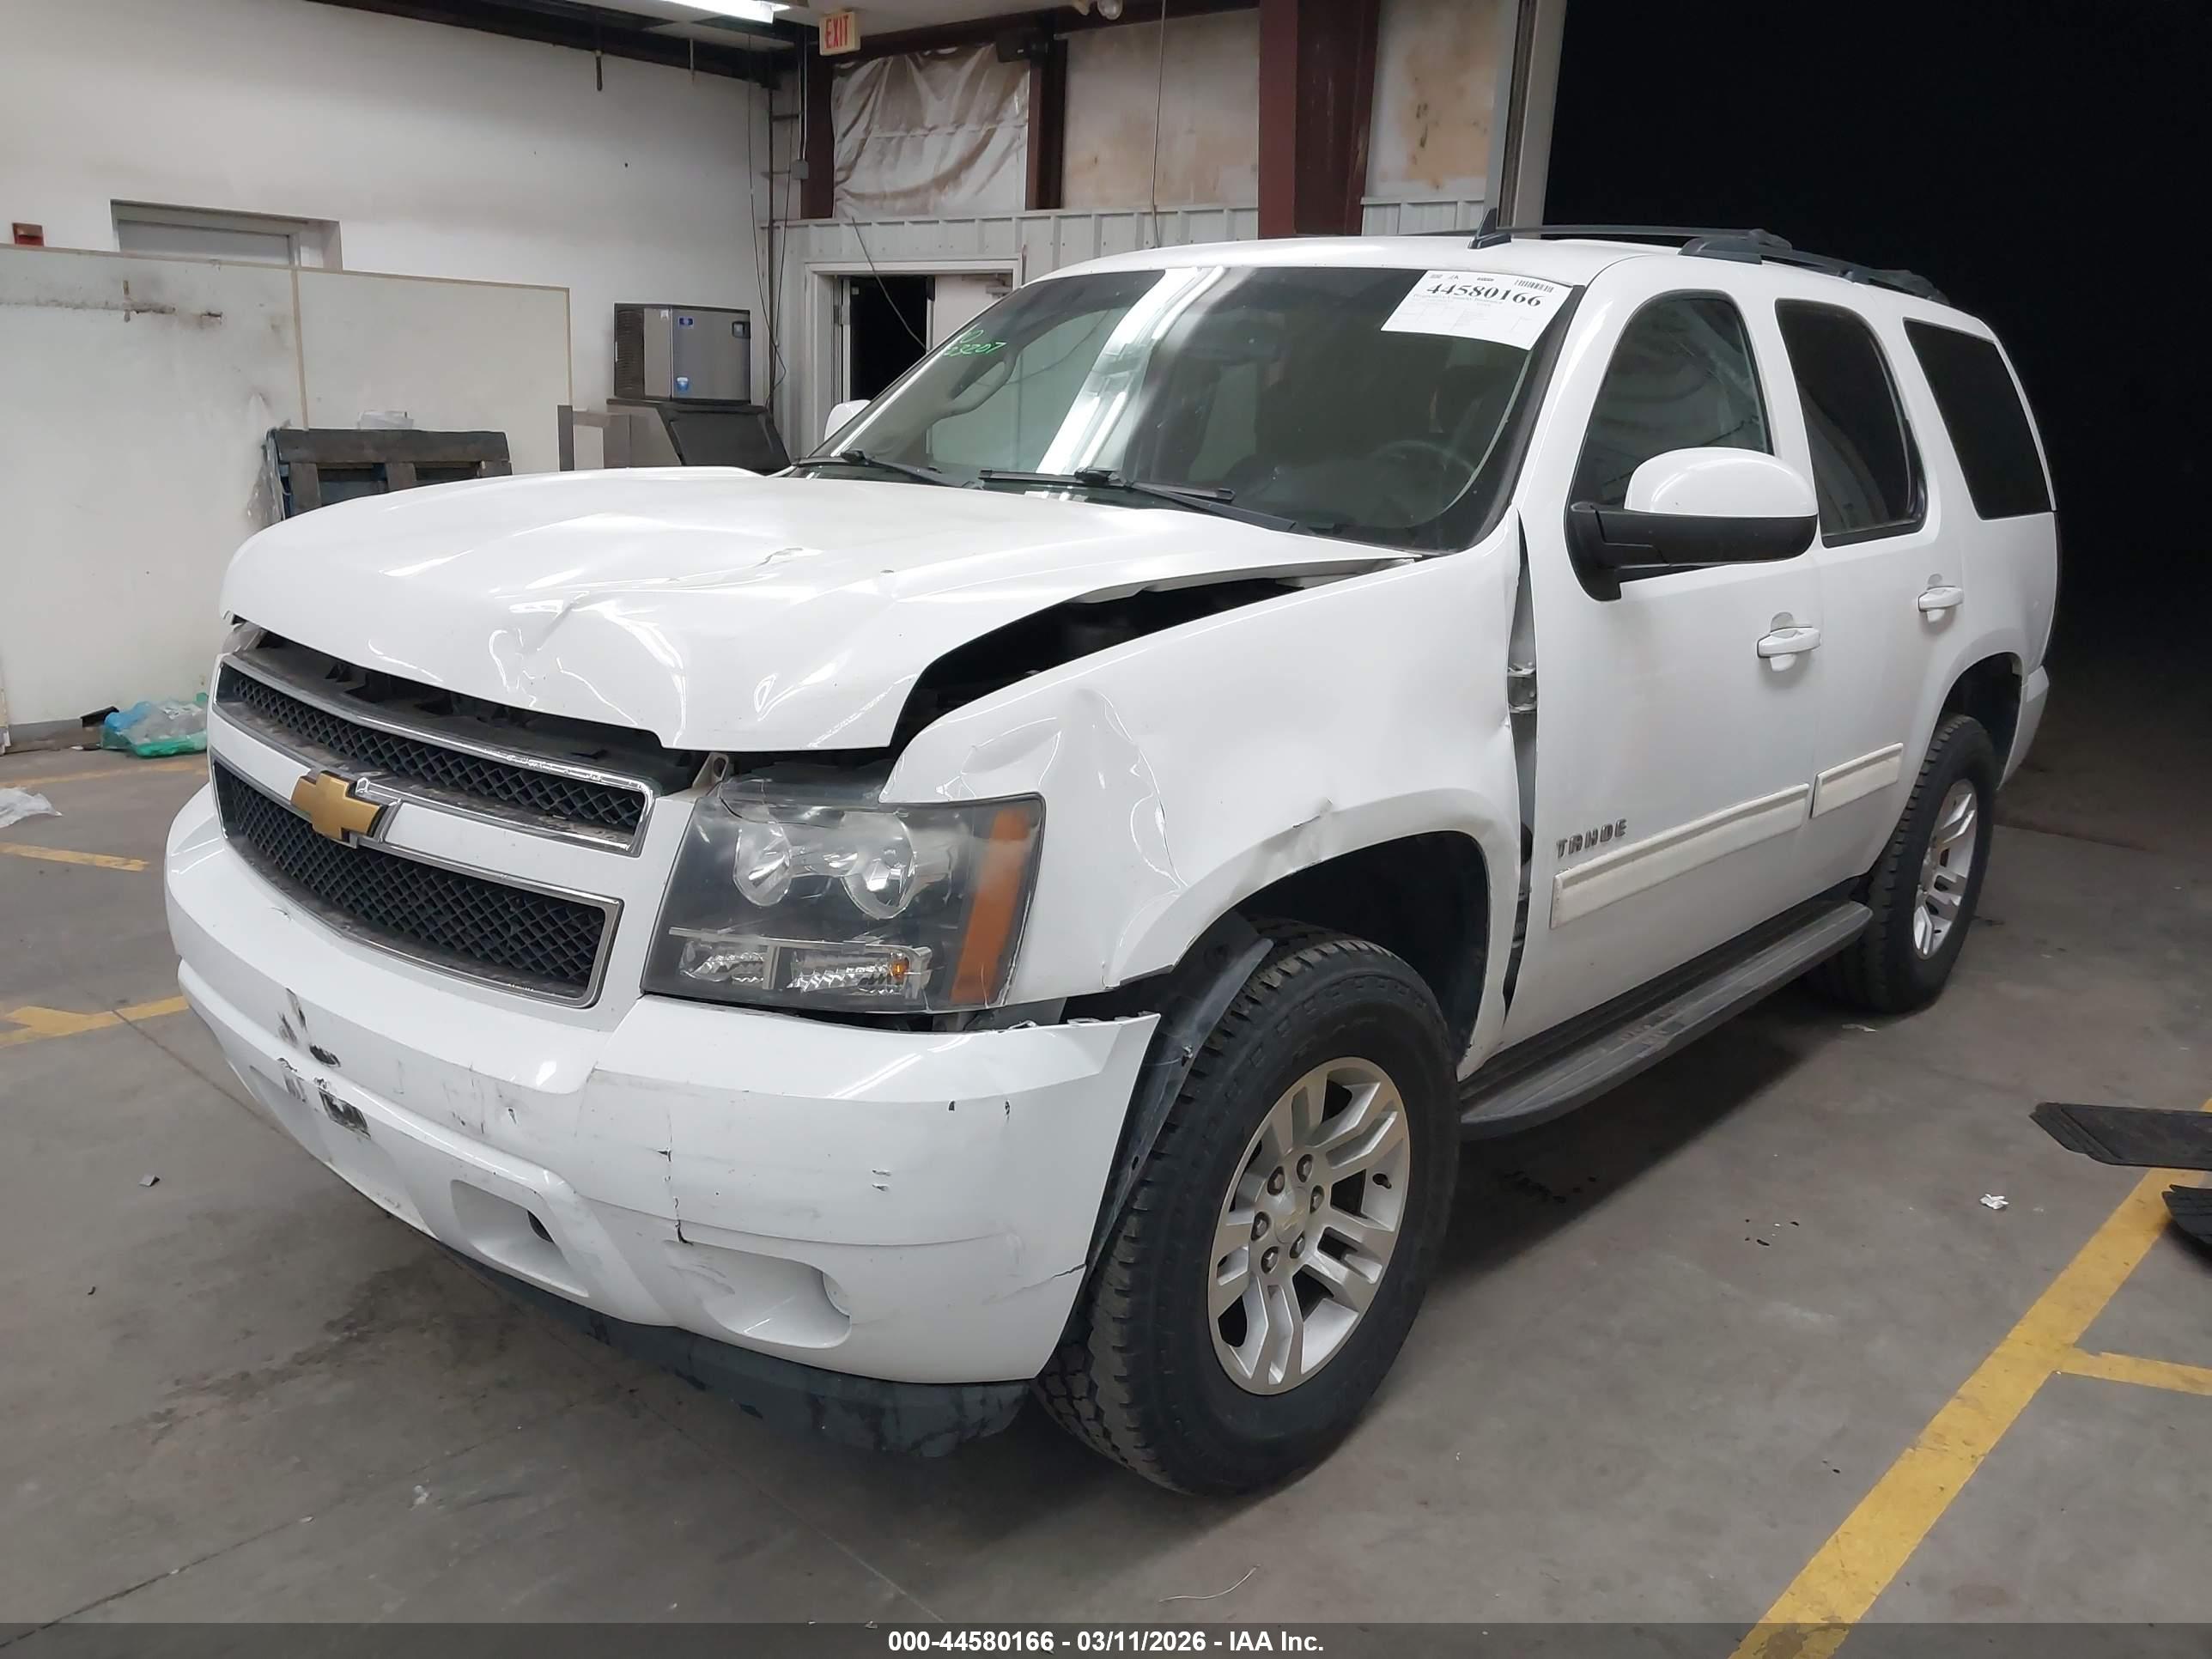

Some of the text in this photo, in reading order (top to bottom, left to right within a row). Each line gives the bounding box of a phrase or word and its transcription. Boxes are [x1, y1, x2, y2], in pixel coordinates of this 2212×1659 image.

[825, 15, 849, 49] EXIT
[1426, 283, 1543, 307] 44580166
[1556, 817, 1627, 859] TAHOE
